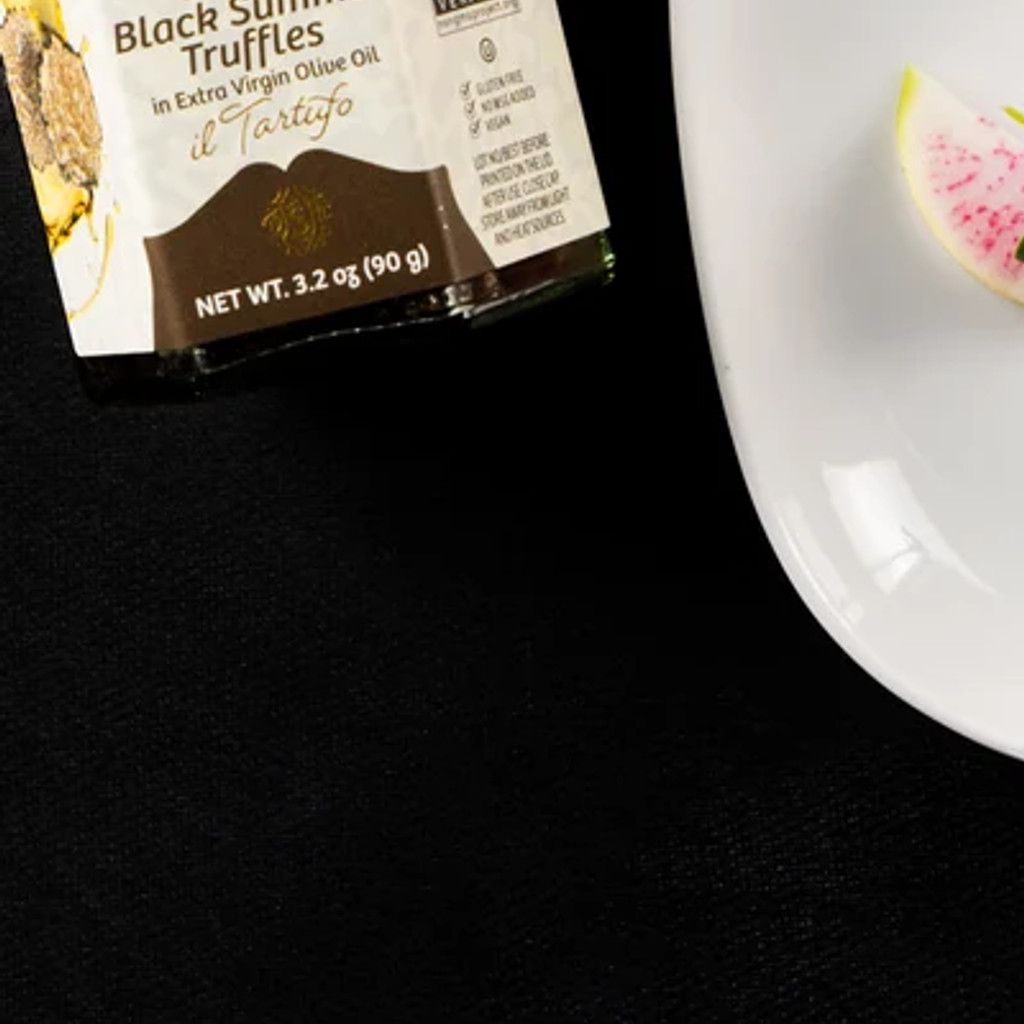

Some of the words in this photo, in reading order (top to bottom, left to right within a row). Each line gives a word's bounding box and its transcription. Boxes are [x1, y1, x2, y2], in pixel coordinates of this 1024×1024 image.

[114, 3, 218, 55] Black
[181, 21, 325, 75] Truffles
[152, 97, 171, 115] in
[174, 87, 228, 110] Extra
[230, 71, 290, 96] Virgin
[294, 55, 347, 81] Olive
[350, 46, 380, 68] Oil
[190, 120, 217, 161] il
[219, 82, 353, 155] Tartufo
[195, 288, 242, 319] NET
[246, 279, 290, 305] WT.
[292, 269, 329, 295] 3.2
[332, 265, 361, 289] oz
[363, 251, 400, 282] (90
[406, 243, 430, 274] g)
